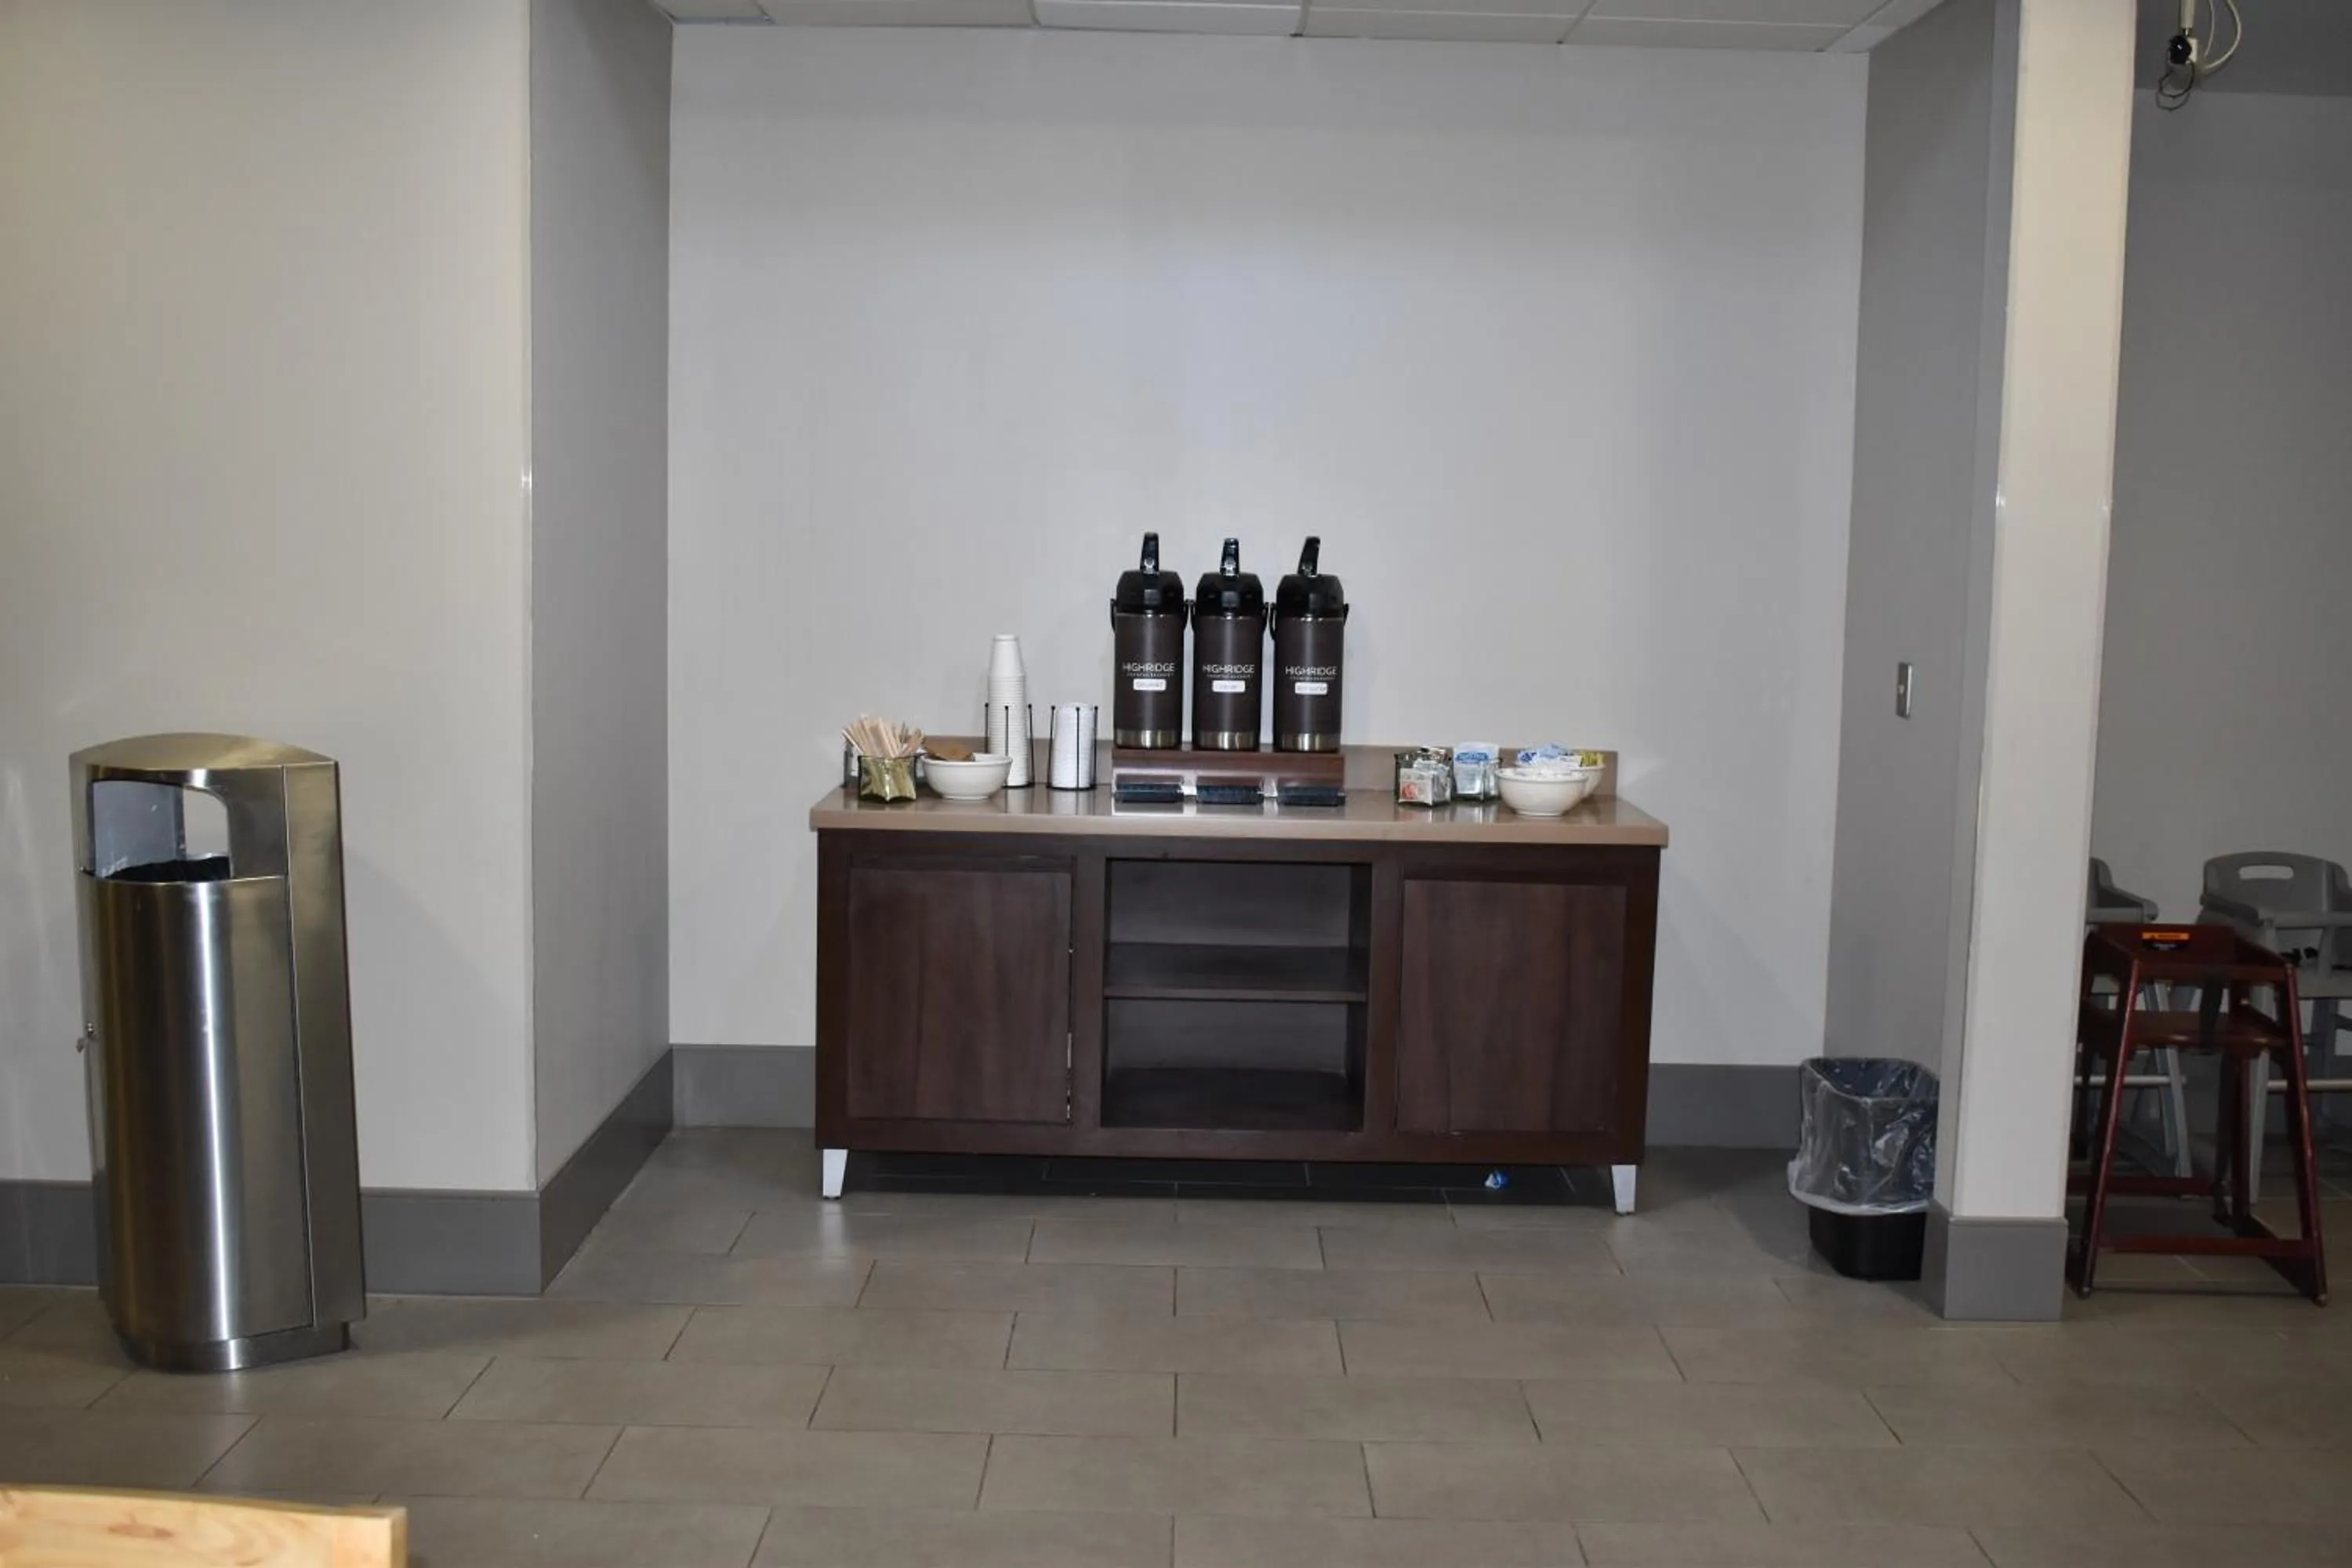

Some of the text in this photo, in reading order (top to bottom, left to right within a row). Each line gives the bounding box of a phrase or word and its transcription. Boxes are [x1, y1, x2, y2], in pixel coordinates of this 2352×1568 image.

[1122, 662, 1176, 672] HIGHRIDGE
[1202, 664, 1255, 673] HIGHRIDGE
[1284, 665, 1338, 675] HIGHRIDGE
